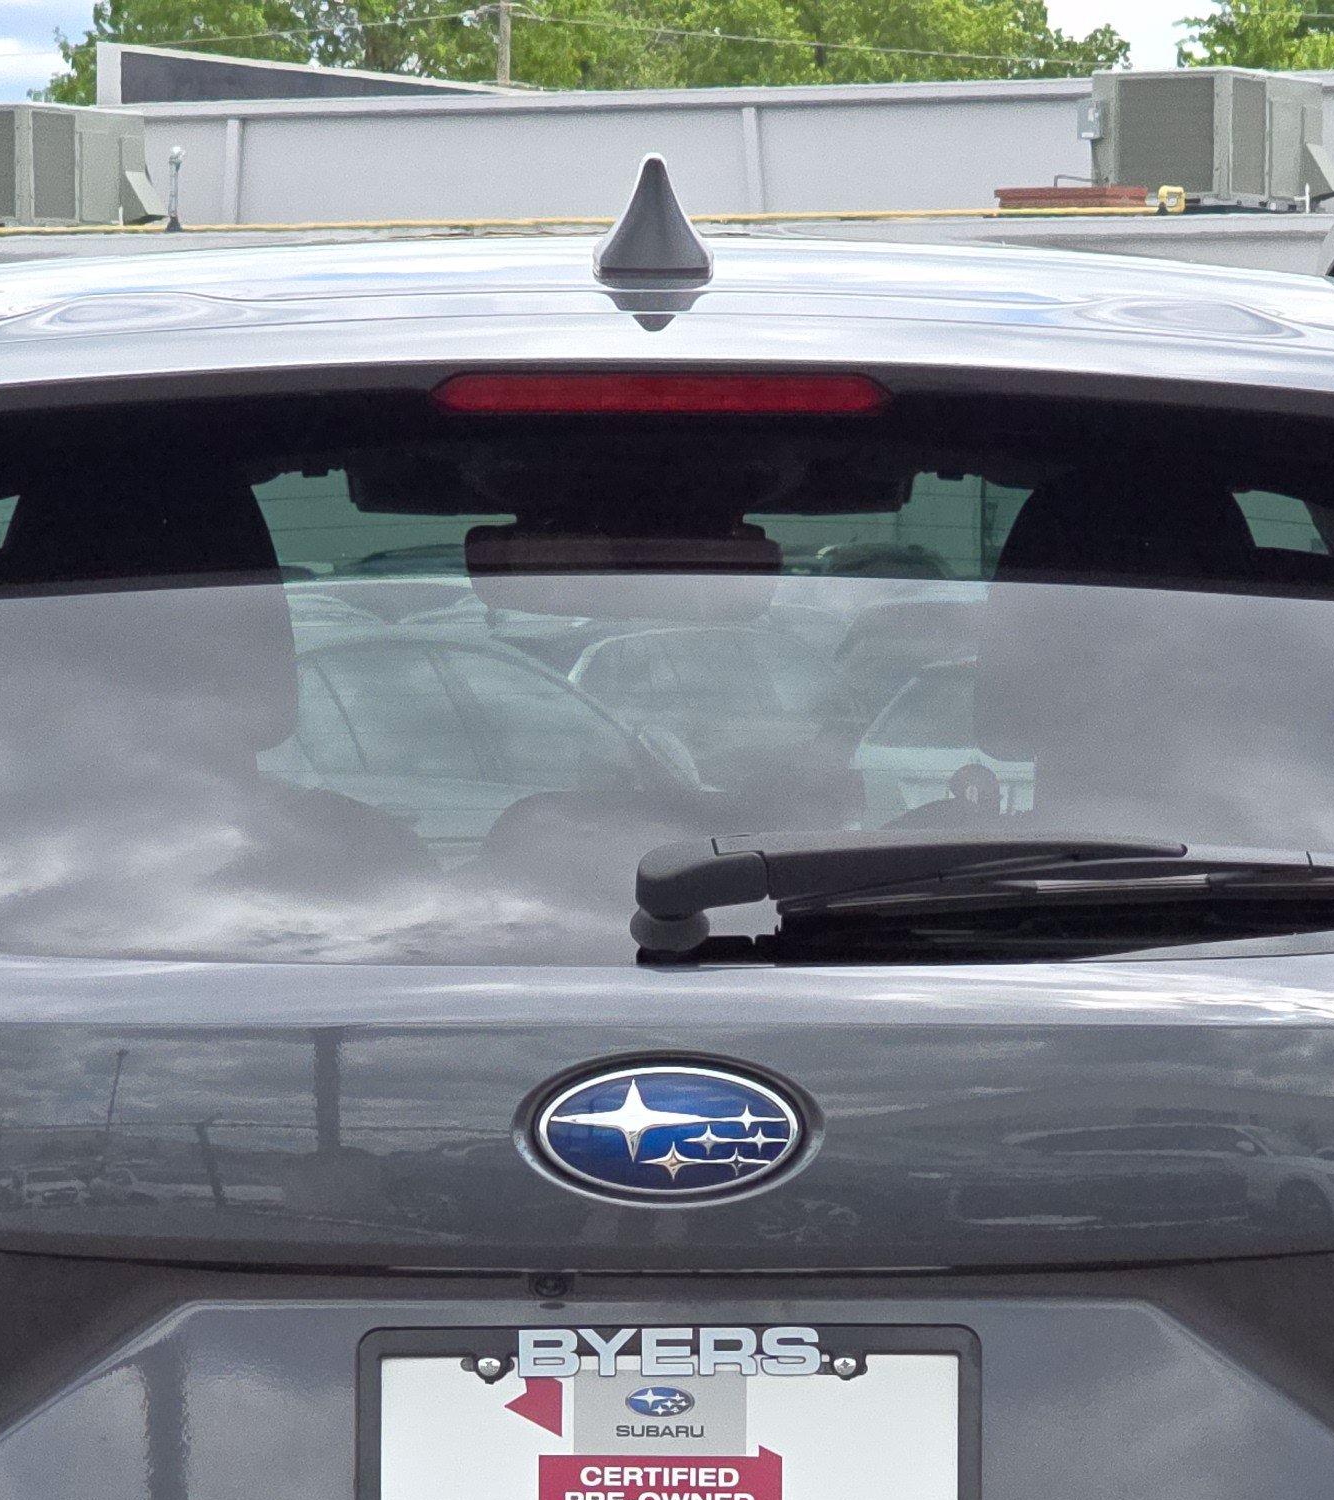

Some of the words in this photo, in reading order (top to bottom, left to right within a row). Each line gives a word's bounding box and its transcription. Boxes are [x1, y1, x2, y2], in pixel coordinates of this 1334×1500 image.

[517, 1326, 821, 1378] BYERS
[615, 1424, 706, 1439] SUBARU
[579, 1466, 740, 1488] CERTIFIED
